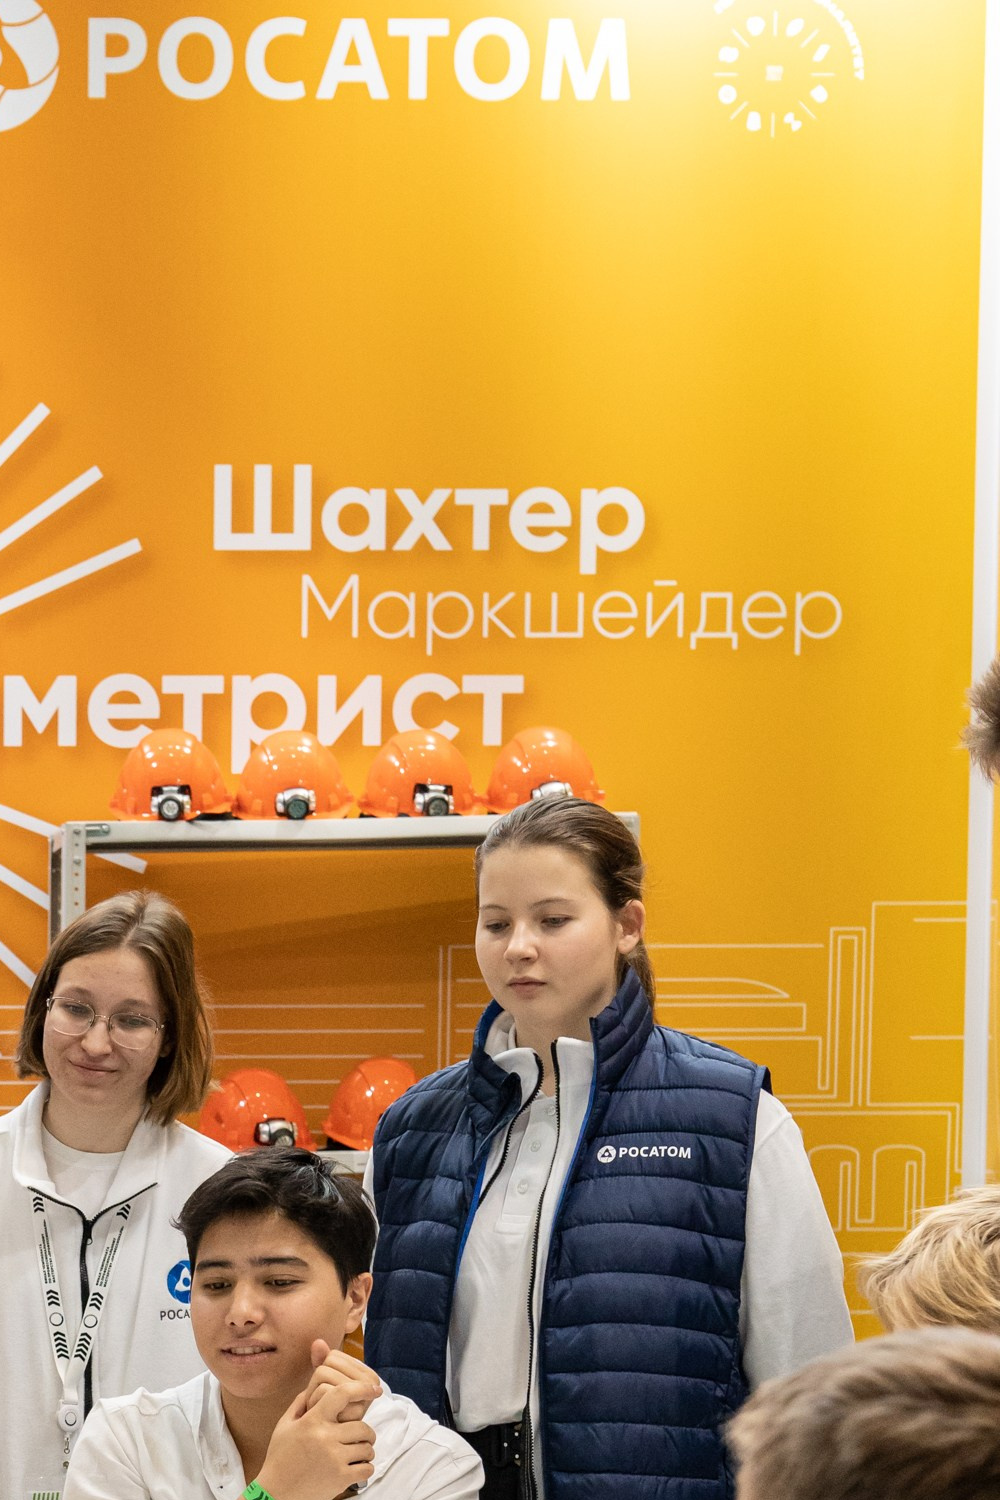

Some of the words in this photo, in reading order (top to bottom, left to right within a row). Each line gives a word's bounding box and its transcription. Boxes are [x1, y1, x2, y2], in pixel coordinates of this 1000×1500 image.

[86, 16, 631, 102] РОСАТОМ
[213, 463, 646, 574] Шахтер
[301, 575, 842, 656] Маркшейдер
[618, 1146, 691, 1159] РОСАТОМ
[160, 1309, 191, 1321] РОСА
